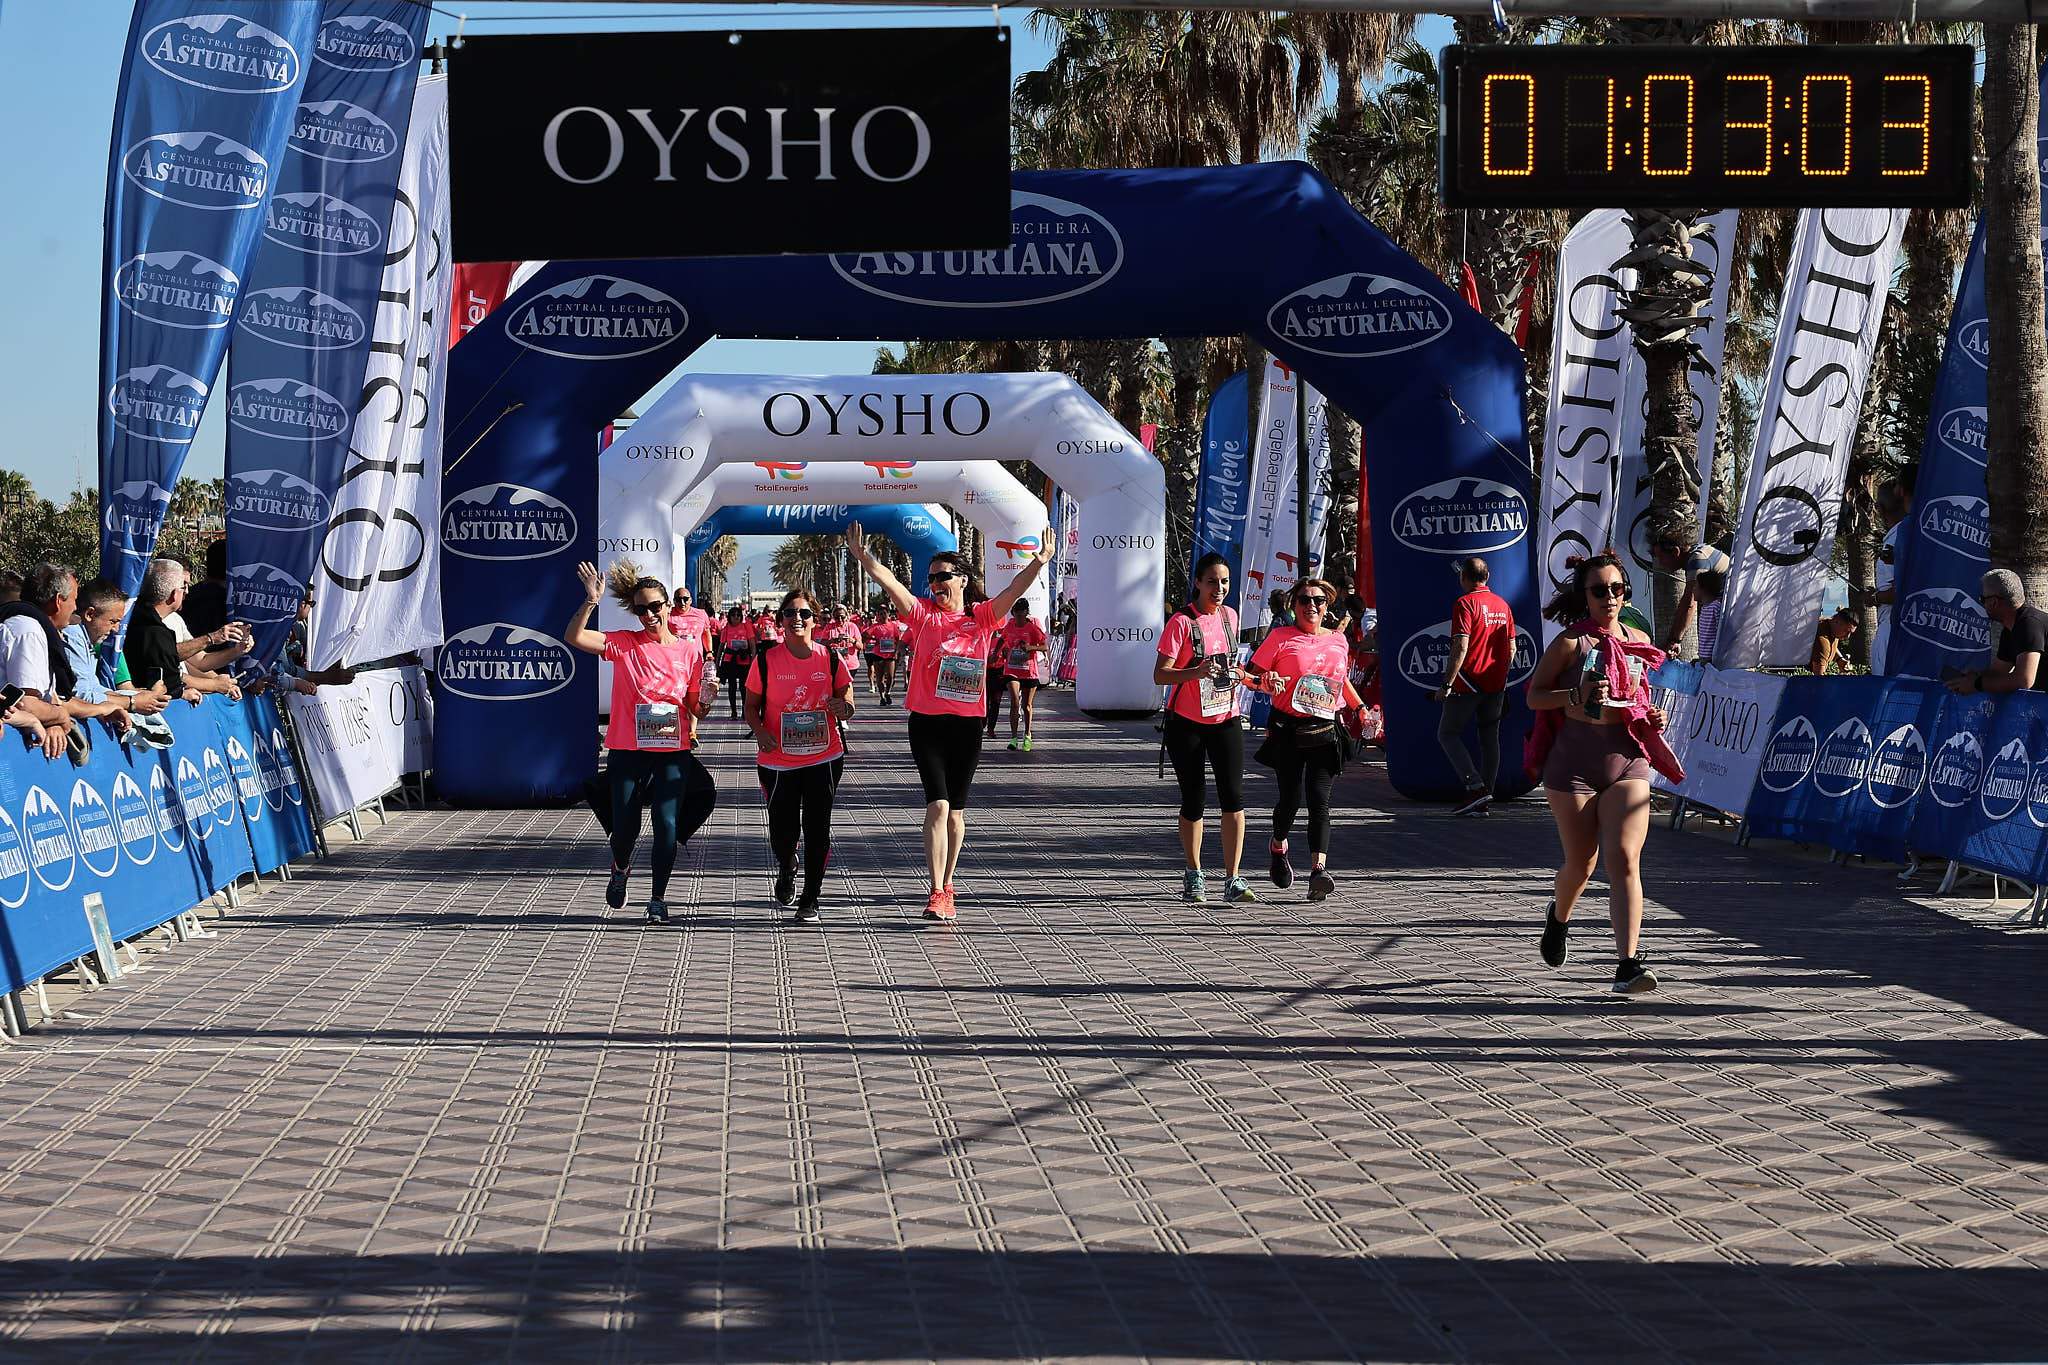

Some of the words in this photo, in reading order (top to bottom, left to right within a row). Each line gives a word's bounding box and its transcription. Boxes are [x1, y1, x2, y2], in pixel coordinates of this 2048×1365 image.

[152, 32, 289, 84] ASTURIANA
[182, 33, 236, 49] CENTRAL
[238, 43, 289, 61] LECHERA
[294, 122, 386, 153] STURIANA
[1483, 73, 1930, 177] 01:03:03
[543, 106, 932, 185] OYSHO
[134, 150, 262, 198] ASTURIANA
[161, 151, 212, 166] CENTRAL
[216, 160, 264, 176] LECHERA
[265, 206, 371, 247] ASTURIANA
[1012, 222, 1092, 234] ECHERA
[851, 243, 1102, 275] ASTURIANA
[121, 271, 234, 315] ASTURIANA
[142, 271, 188, 285] CENTRAL
[194, 280, 236, 293] LECHERA
[265, 302, 307, 315] CENTRAL
[311, 310, 353, 322] LECHERA
[546, 303, 605, 313] CENTRAL
[611, 304, 672, 314] LECHERA
[1307, 301, 1368, 314] CENTRAL
[1374, 298, 1432, 310] LECHERA
[242, 300, 355, 341] ASTURIANA
[516, 307, 674, 337] ASTURIANA
[1282, 307, 1441, 338] ASTURIANA
[230, 392, 339, 432] ASTURIANA
[251, 394, 293, 406] CENTRAL
[297, 402, 338, 413] LECHERA
[763, 392, 990, 437] OYSHO
[1547, 273, 1628, 592] OYSHO
[626, 445, 694, 461] OYSHO
[1056, 440, 1124, 456] OYSHO
[755, 484, 809, 493] TotalEnergies
[864, 483, 918, 492] TotalEnergies
[1207, 440, 1246, 541] Marlene
[225, 496, 320, 522] STURIANA
[461, 510, 509, 518] CENTRAL
[514, 510, 565, 519] LECHERA
[1421, 503, 1474, 513] CENTRAL
[1478, 501, 1520, 510] LECHERA
[444, 512, 568, 541] ASTURIANA
[1400, 509, 1525, 536] ASTURIANA
[1923, 508, 1991, 548] ASTURIA
[598, 538, 659, 553] OYSHO
[1092, 535, 1155, 550] OYSHO
[996, 564, 1027, 572] TotalEne
[1091, 627, 1154, 642] OYSHO
[1902, 600, 1990, 645] ASTURIANA
[442, 651, 566, 681] ASTURIANA
[459, 649, 505, 657] CENTRAL
[511, 649, 562, 658] LECHERA
[1690, 691, 1759, 754] OYSHO
[1764, 744, 1811, 772] ASTURIANA
[1816, 745, 1866, 779] ASTURIANA
[1871, 752, 1920, 790] ASTURIANA
